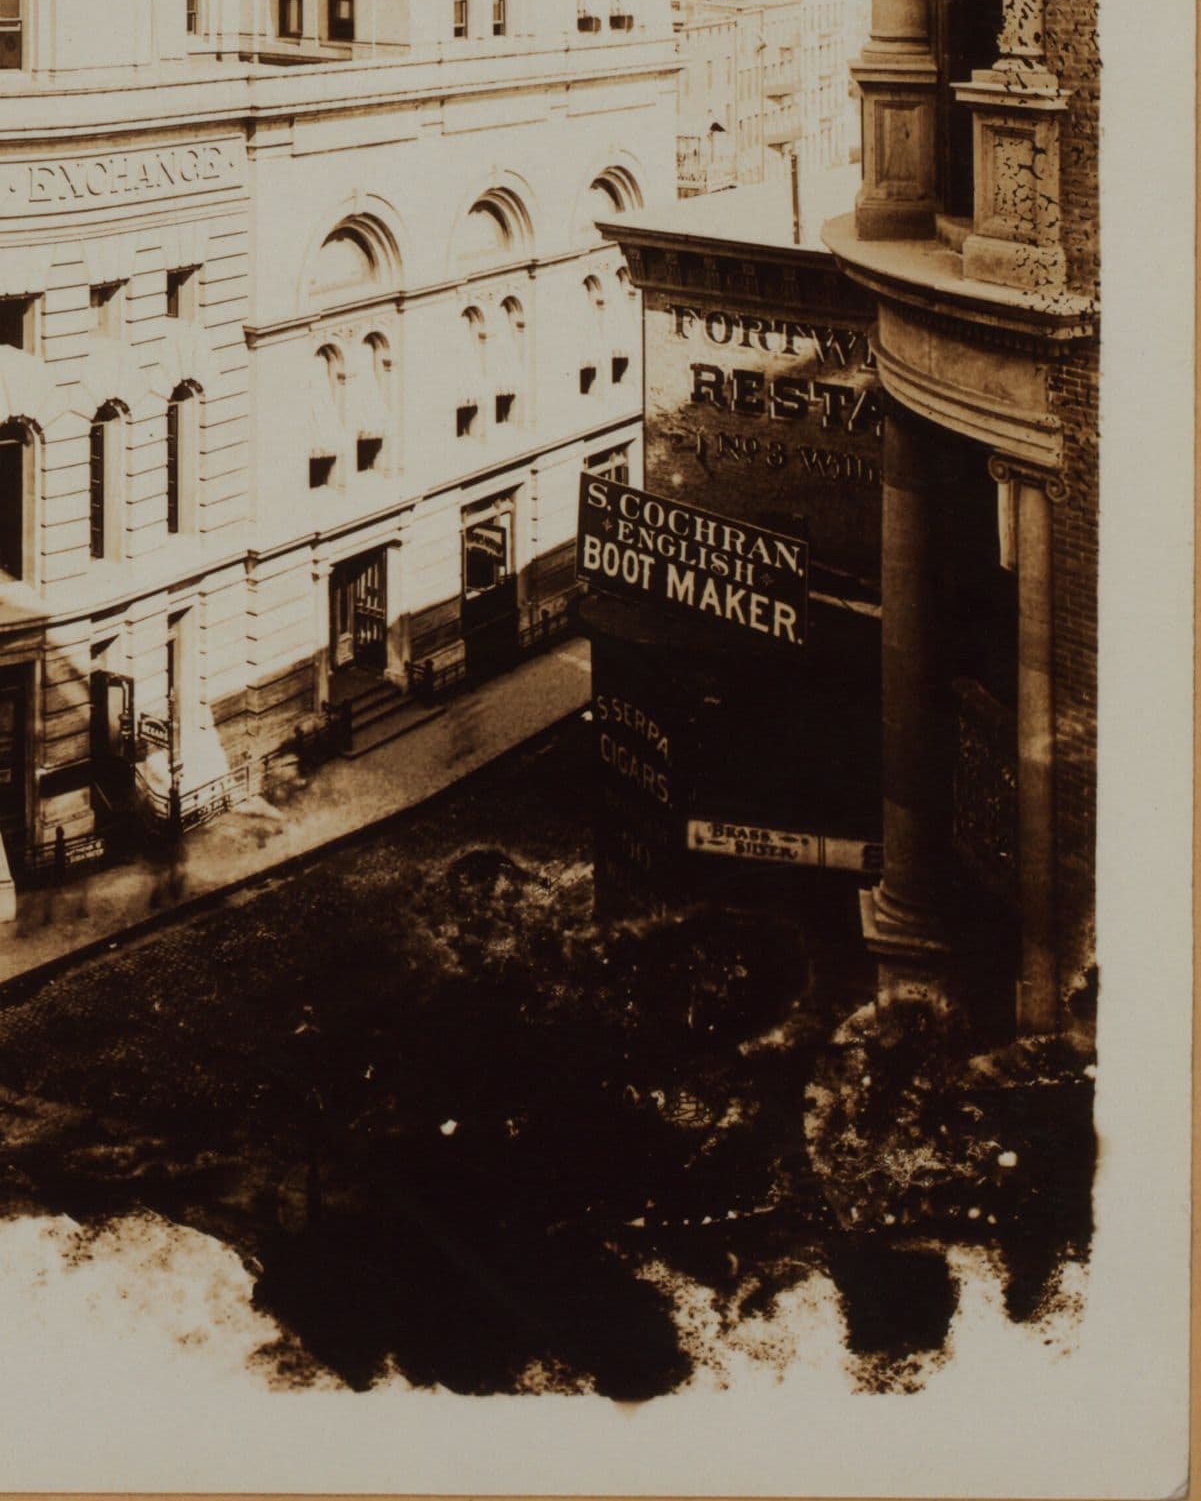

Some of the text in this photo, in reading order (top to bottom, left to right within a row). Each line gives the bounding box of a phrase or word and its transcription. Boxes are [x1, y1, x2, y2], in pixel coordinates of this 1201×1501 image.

[28, 147, 223, 203] EXCHANGE
[586, 482, 612, 512] S.
[582, 533, 657, 591] BOOT
[616, 518, 756, 587] ENGLISH
